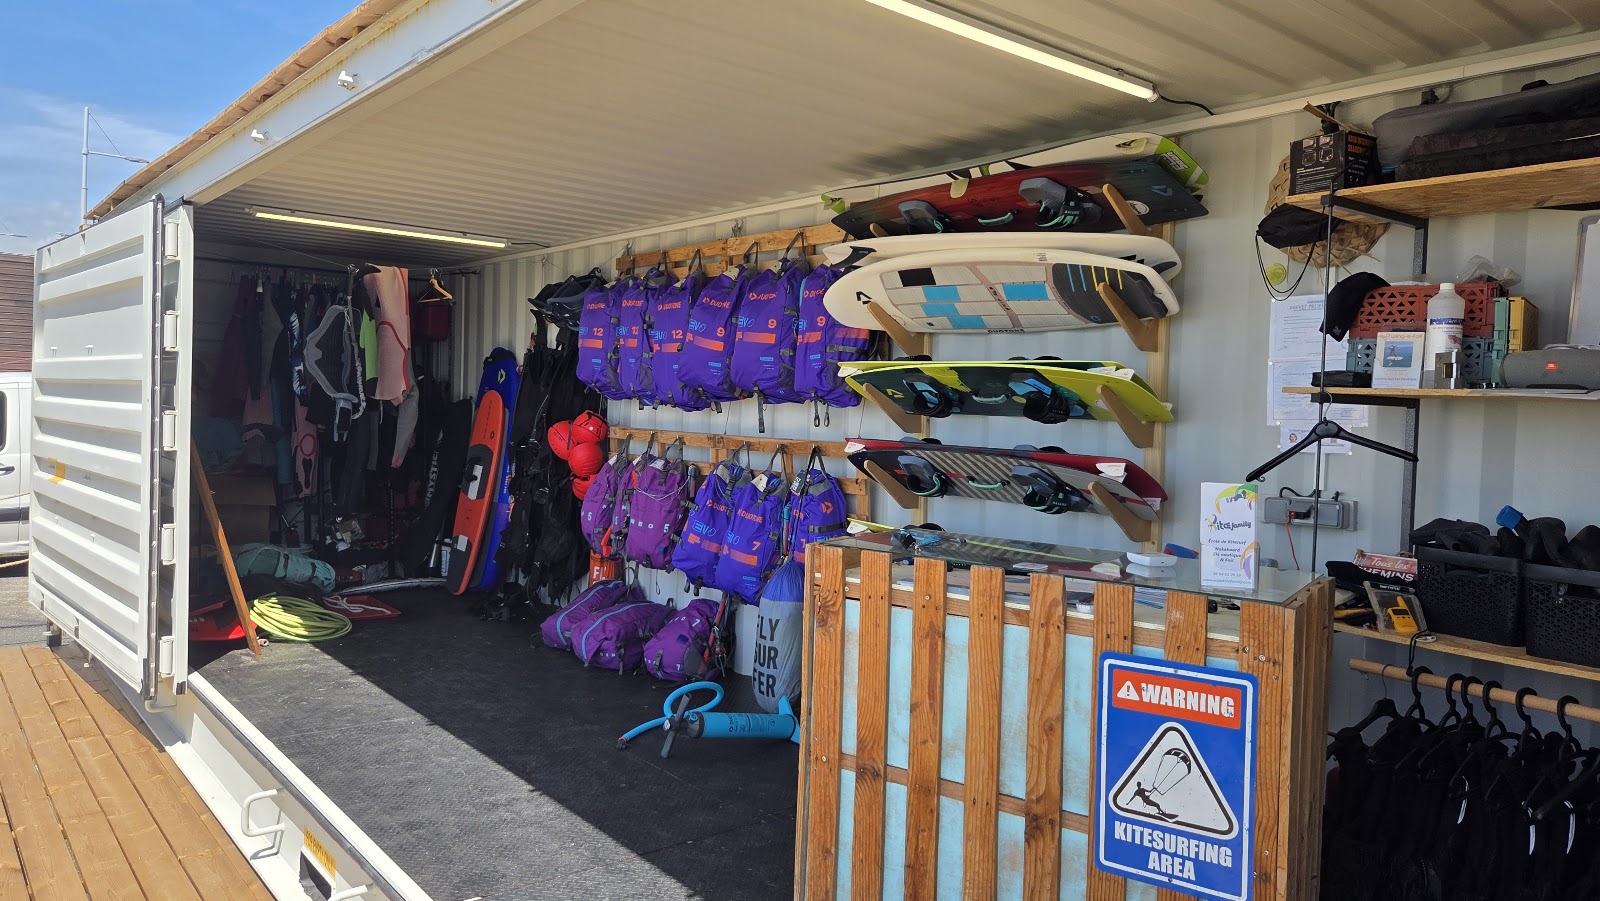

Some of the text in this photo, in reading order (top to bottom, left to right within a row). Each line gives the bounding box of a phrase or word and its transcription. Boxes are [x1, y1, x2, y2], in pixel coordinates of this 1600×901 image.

[768, 319, 777, 329] 9
[817, 316, 826, 327] 9
[593, 328, 603, 336] 12
[672, 330, 683, 338] 12
[717, 327, 725, 337] 9
[663, 523, 670, 533] 5
[752, 541, 762, 551] 7
[1371, 556, 1409, 570] Tous les
[1359, 567, 1414, 582] HEMINS
[692, 618, 701, 627] 7
[757, 614, 781, 641] LY
[1141, 682, 1235, 718] WARNING
[1114, 820, 1233, 868] KITESURFING
[1148, 850, 1196, 881] AREA
